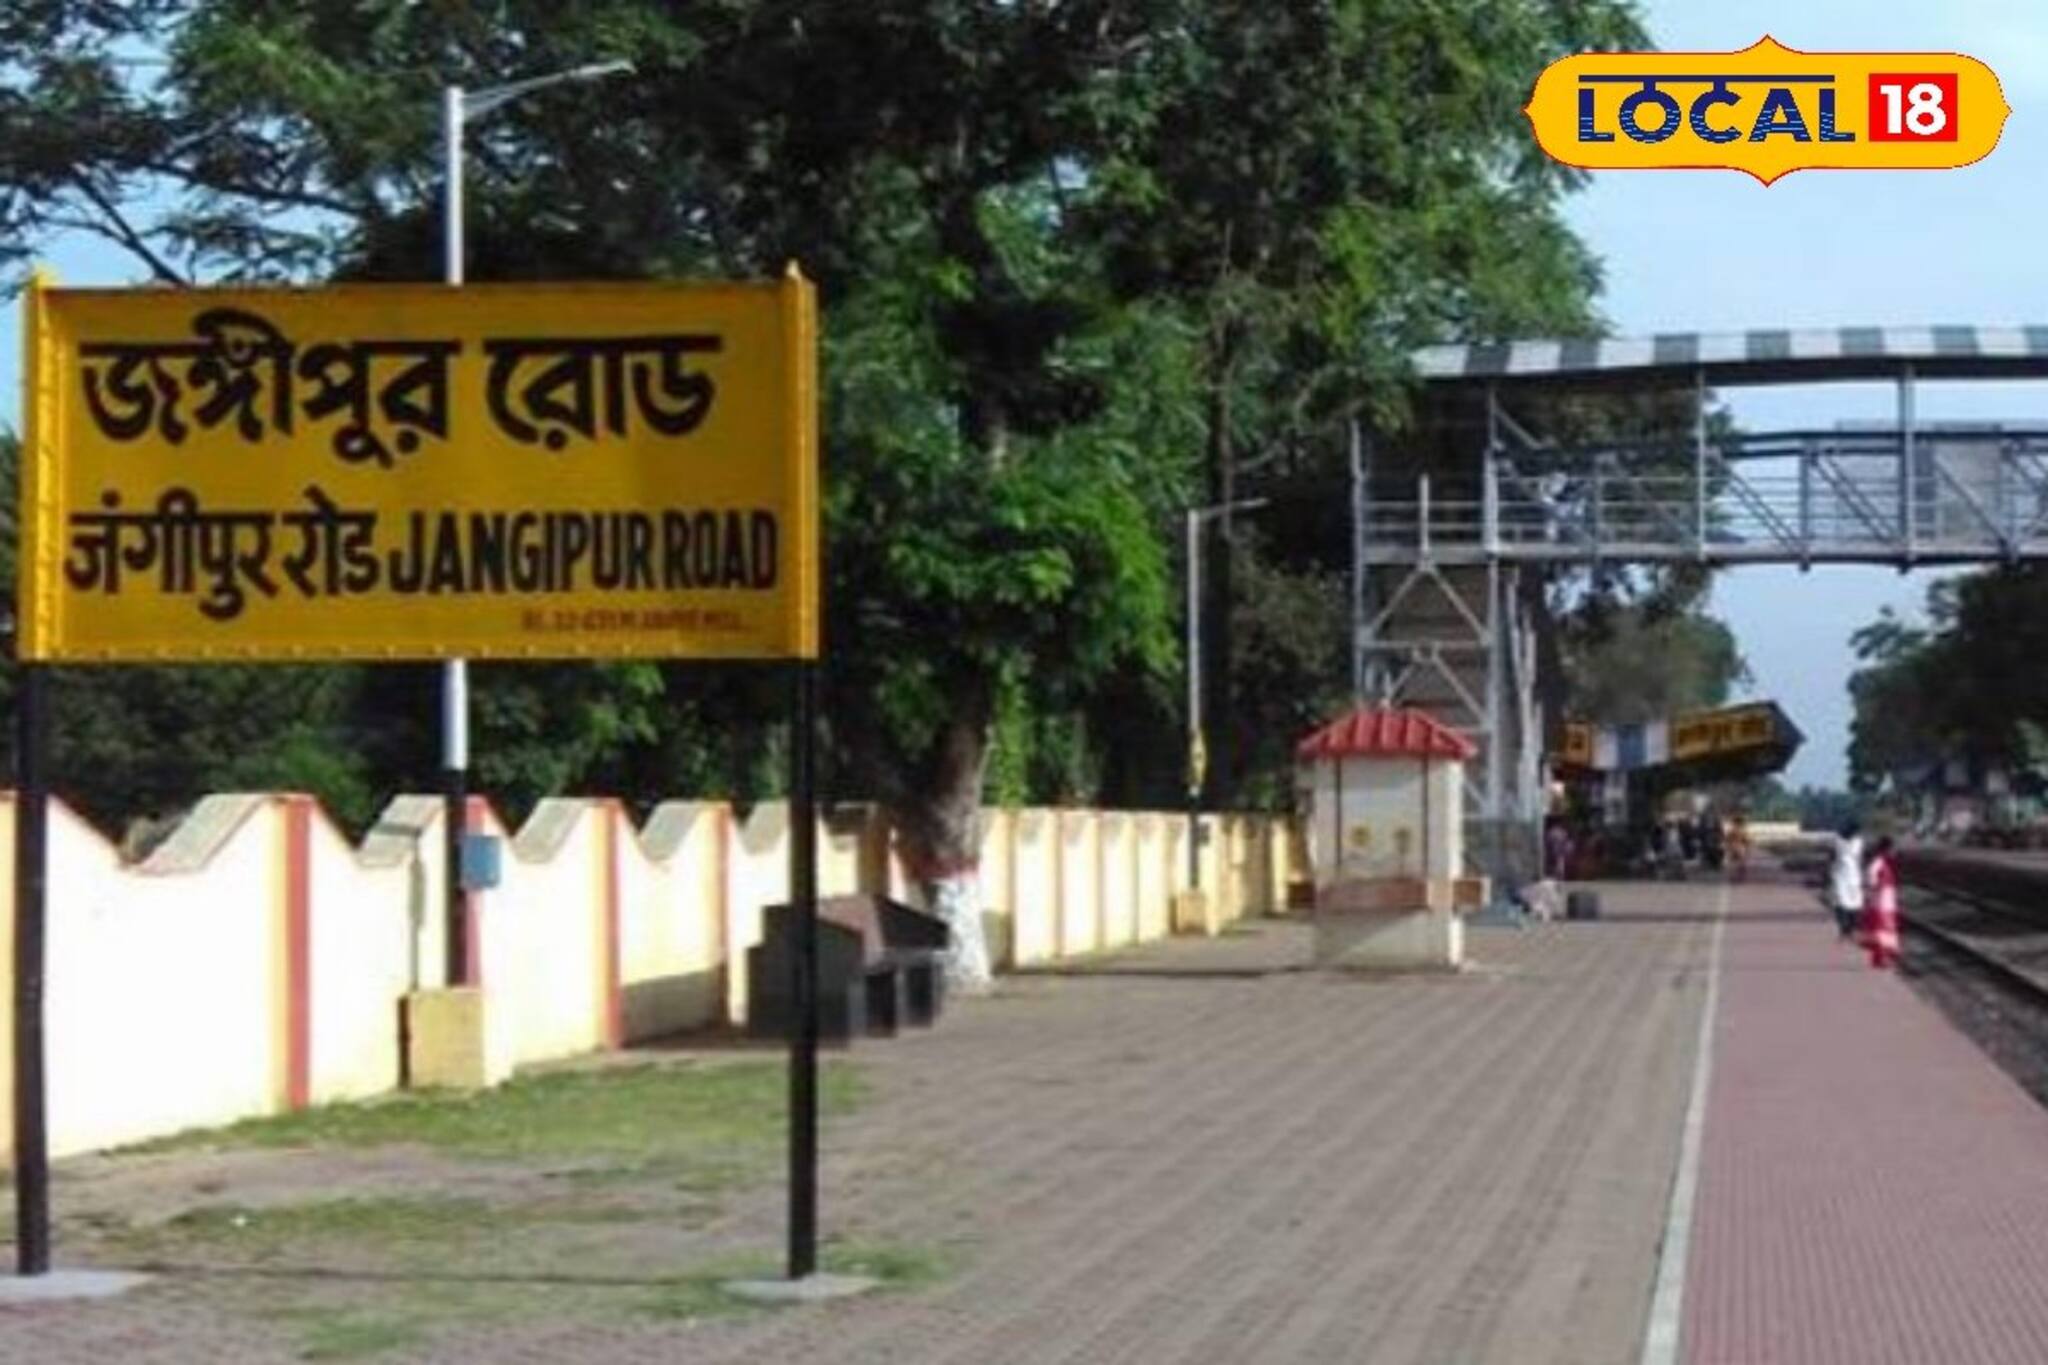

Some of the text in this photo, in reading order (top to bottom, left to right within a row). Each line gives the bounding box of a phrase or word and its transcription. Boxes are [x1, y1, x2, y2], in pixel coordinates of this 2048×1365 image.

[481, 334, 723, 450] রোড
[64, 484, 380, 622] जंगीपुर रोड
[387, 510, 779, 594] JANGIPUR ROAD
